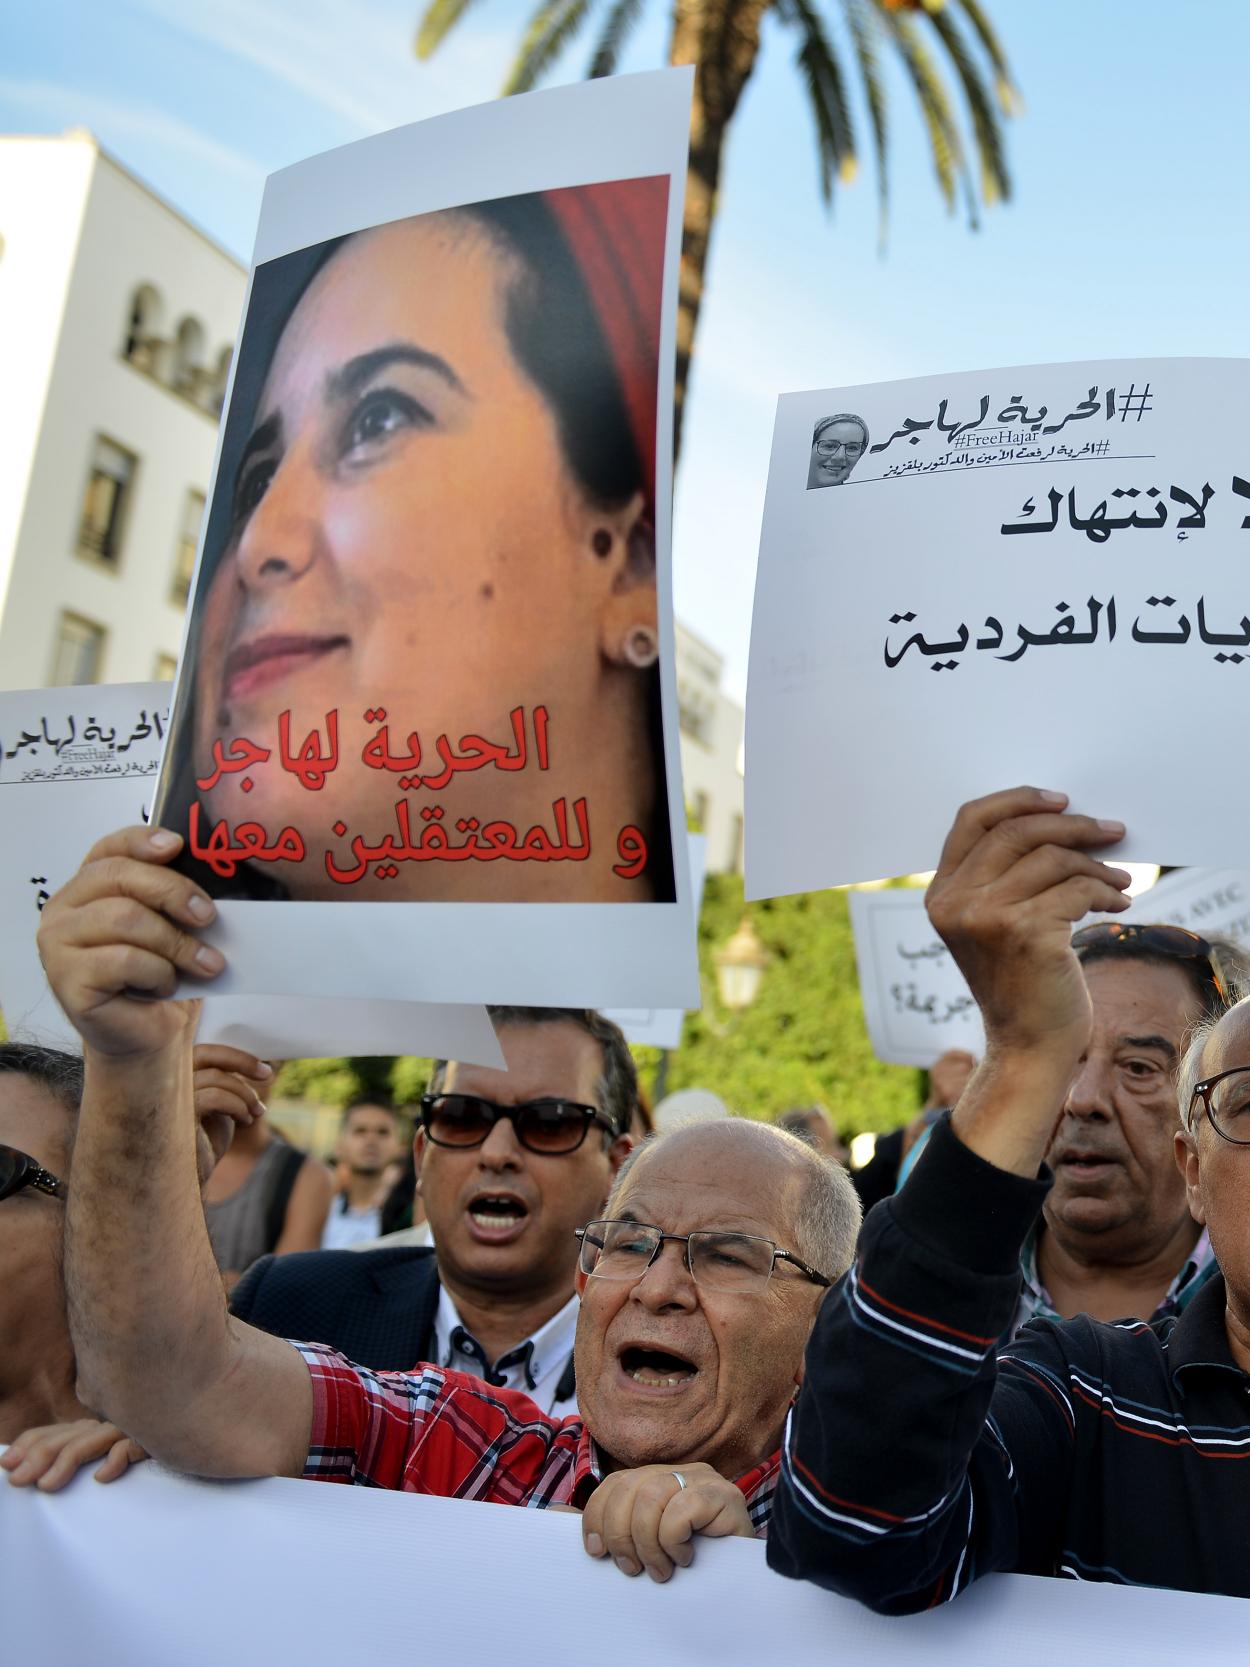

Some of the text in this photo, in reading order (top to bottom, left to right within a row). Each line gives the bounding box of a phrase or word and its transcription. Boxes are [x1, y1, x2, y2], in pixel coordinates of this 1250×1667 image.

[869, 395, 990, 454] لهاجر
[954, 430, 1039, 448] #FreeHajar
[1000, 481, 1215, 543] لإنتهاك
[884, 594, 1117, 672] الفردية
[83, 707, 169, 753] الحرية
[196, 705, 550, 793] الحرية لهاجر
[188, 797, 648, 885] و للمعتقلين معها
